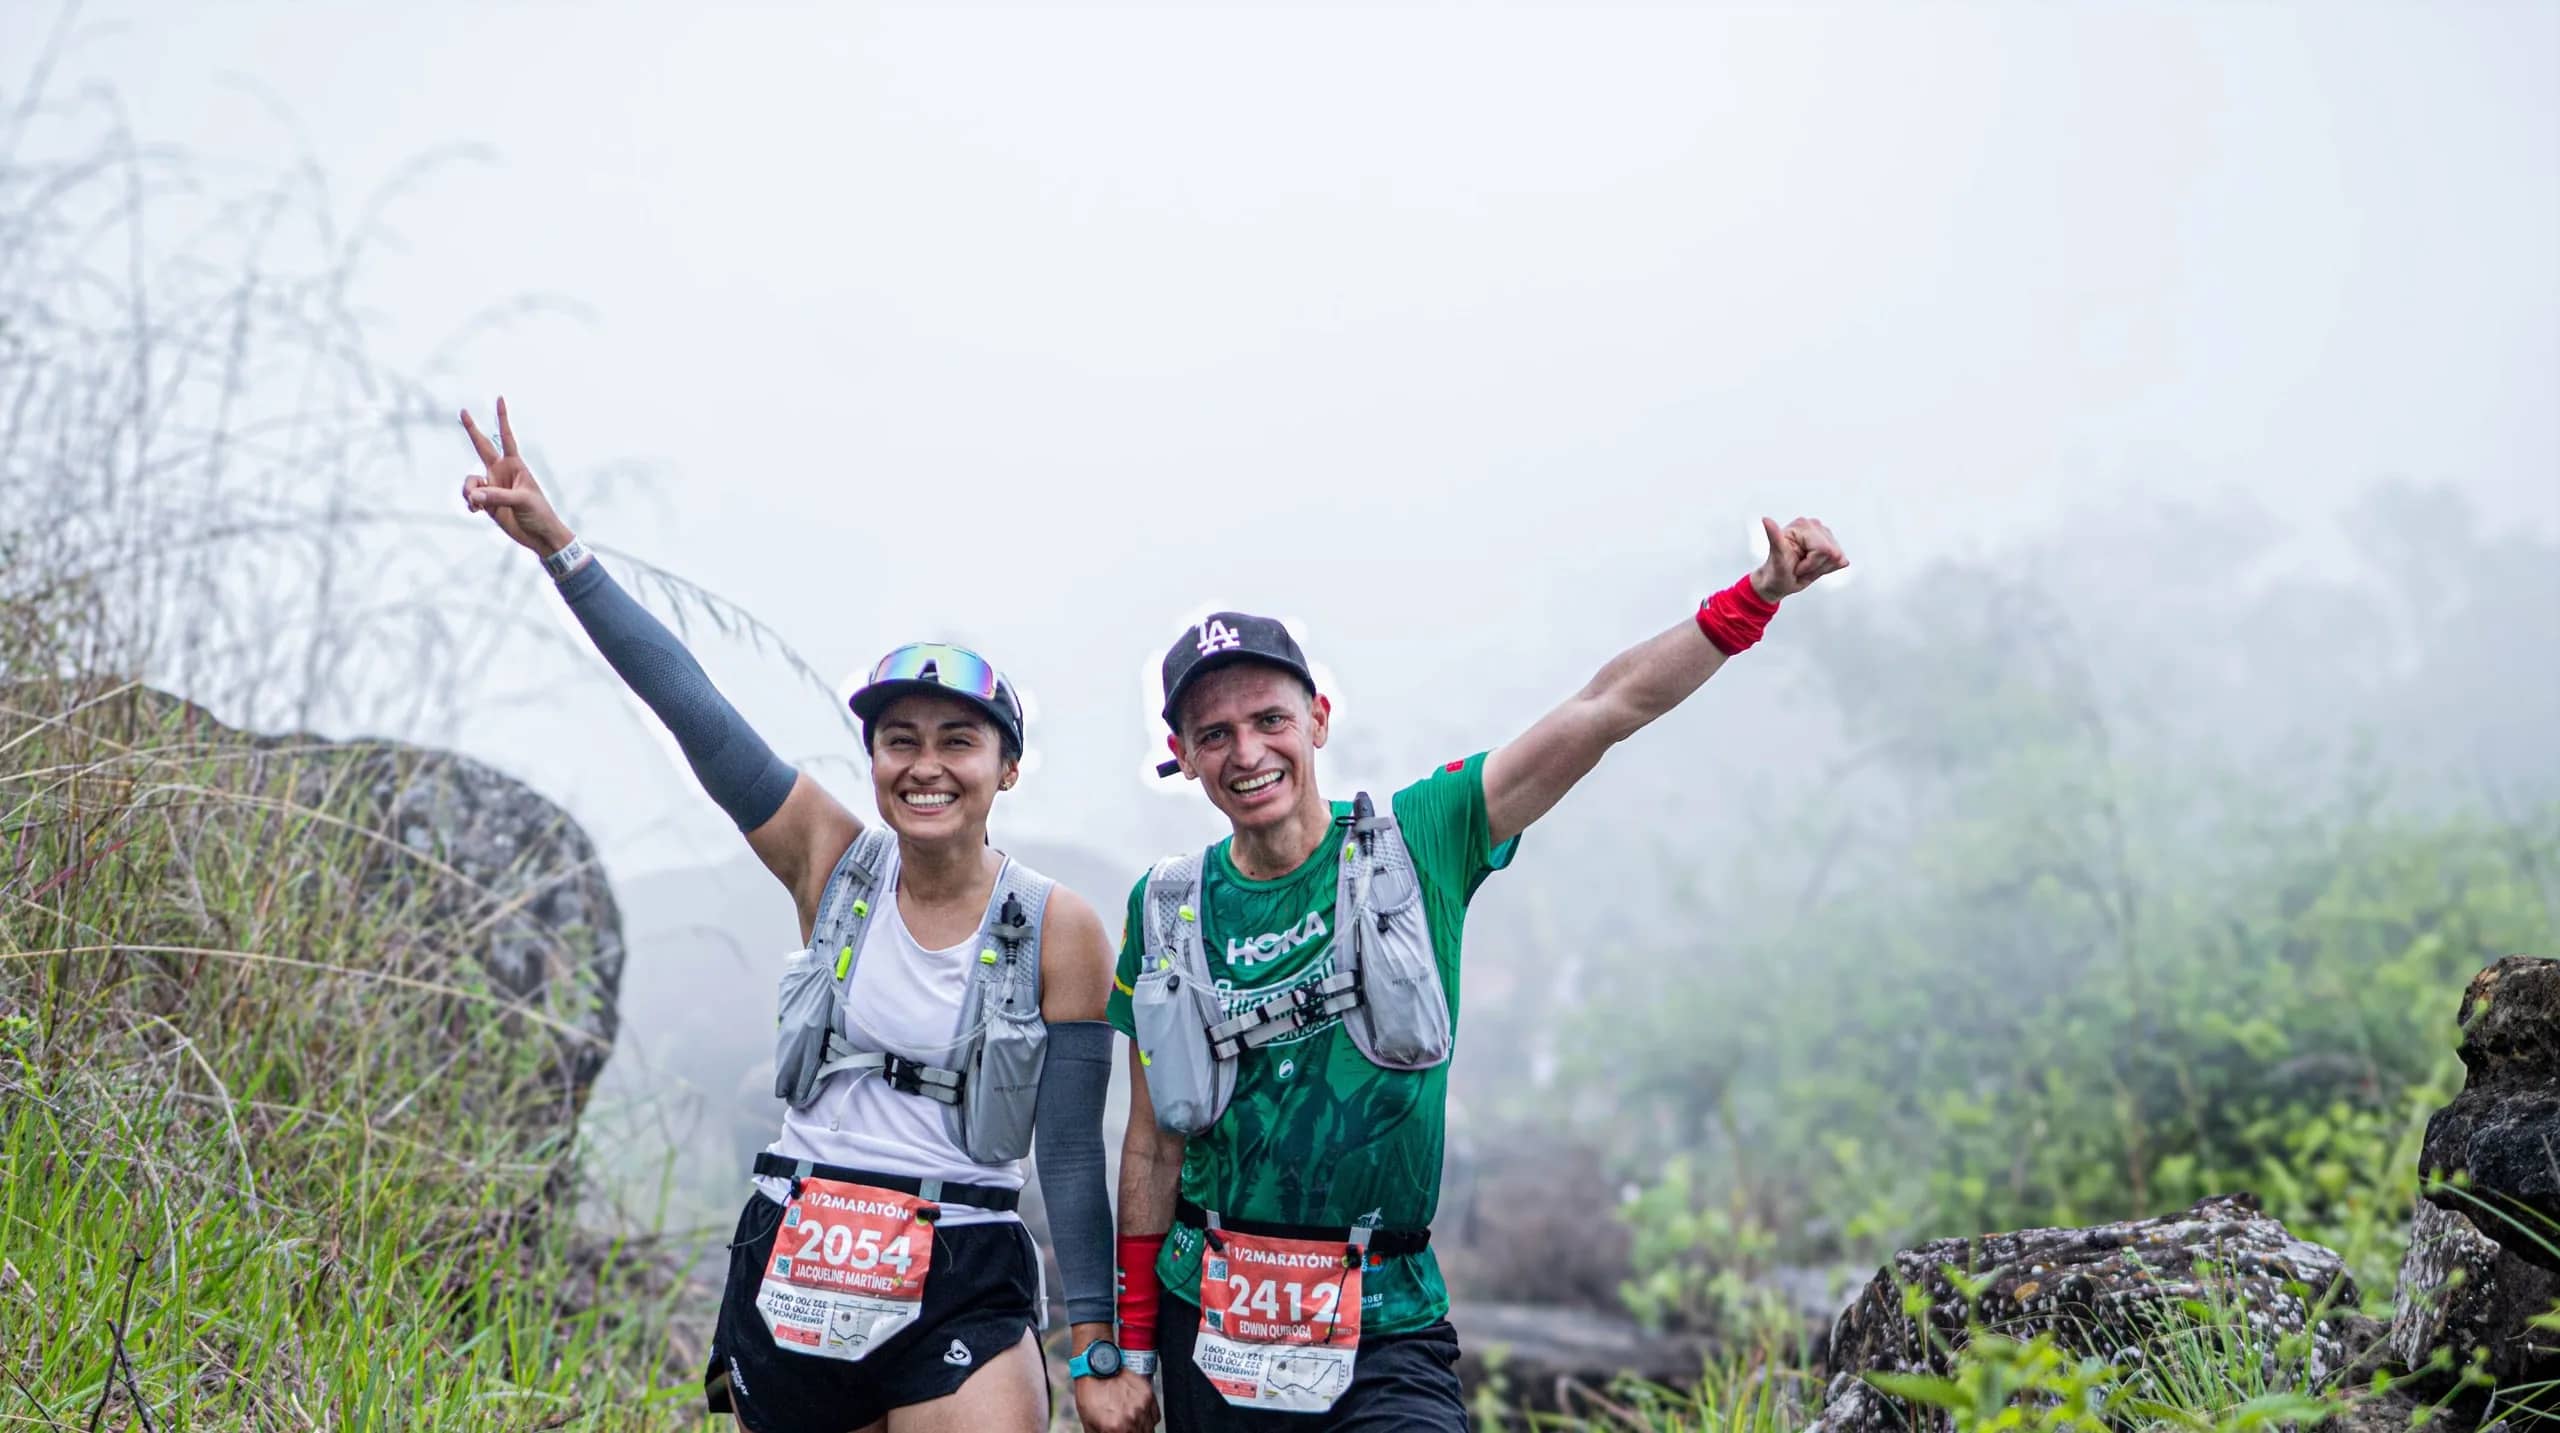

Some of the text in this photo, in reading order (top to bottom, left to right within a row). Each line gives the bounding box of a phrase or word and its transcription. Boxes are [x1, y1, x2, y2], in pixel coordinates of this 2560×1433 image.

[1197, 620, 1240, 657] LA
[1226, 910, 1328, 966] HOKA
[810, 1191, 909, 1221] 1/2MARATÓN
[795, 1219, 913, 1275] 2054
[1234, 1246, 1333, 1269] 1/2MARATÓN
[795, 1263, 845, 1284] JACQUELINE
[845, 1271, 894, 1291] MARTÍNEZ
[767, 1299, 791, 1311] 0117
[793, 1305, 810, 1315] 700
[795, 1296, 812, 1306] 700
[1228, 1274, 1342, 1324] 2412
[1239, 1320, 1313, 1340] EDWIN QUIROGA
[1201, 1353, 1224, 1364] 0117
[1204, 1343, 1226, 1355] 0091
